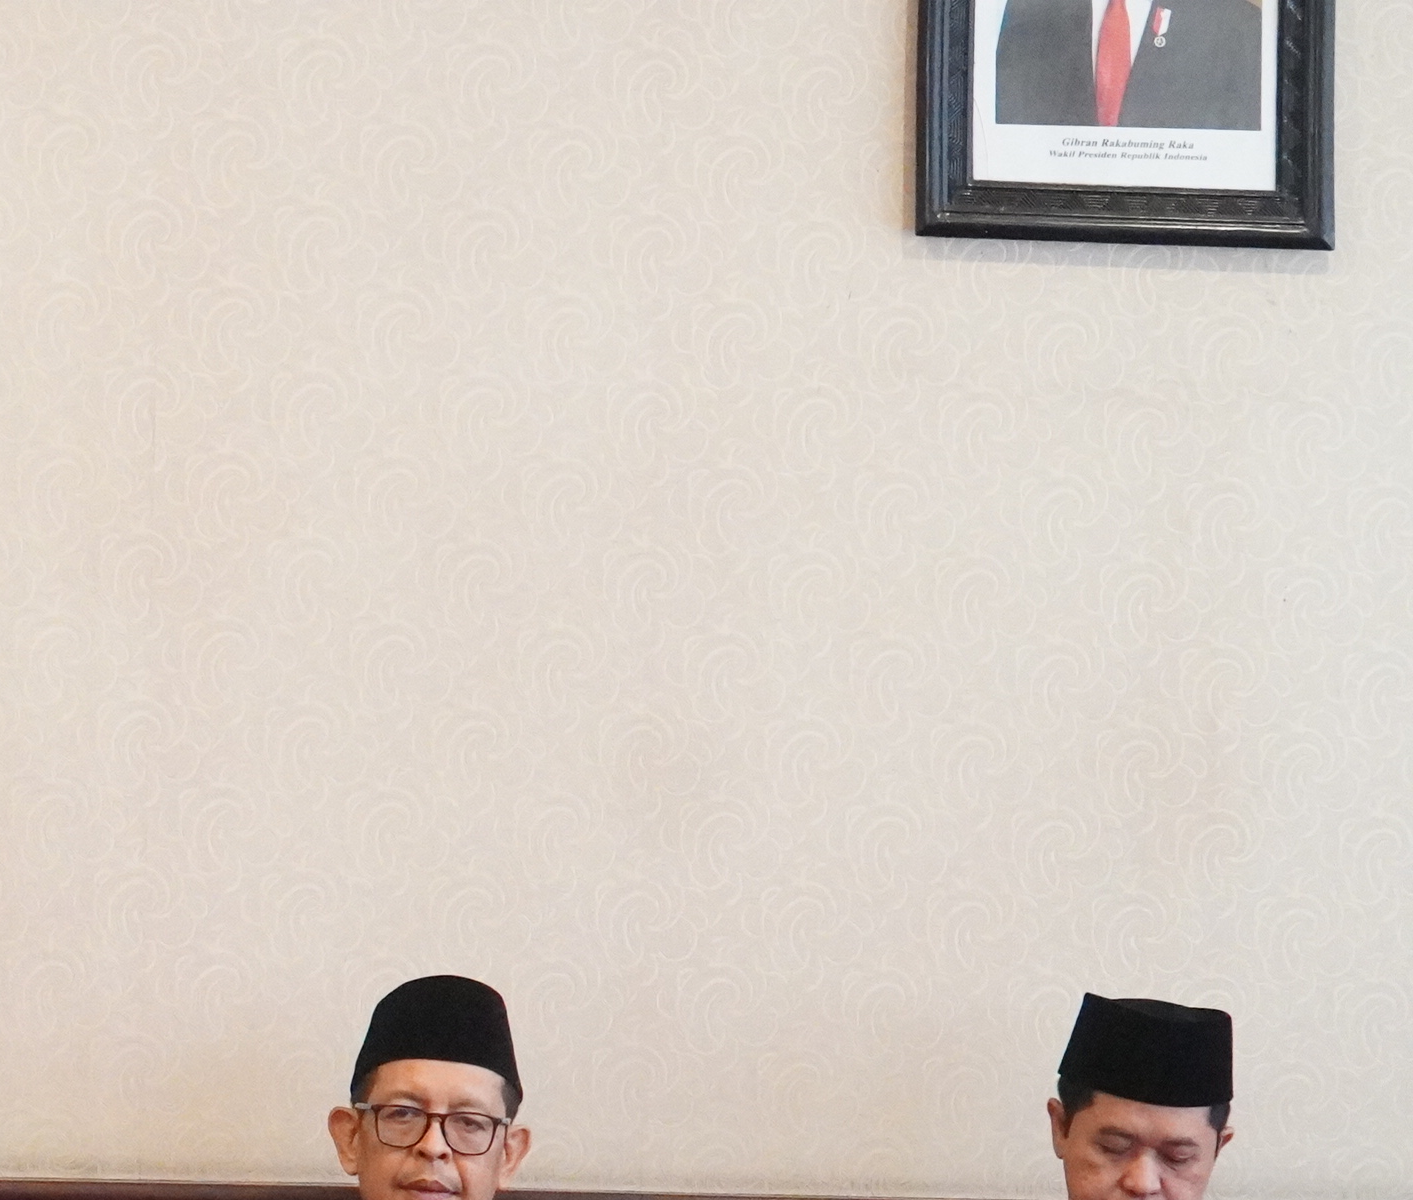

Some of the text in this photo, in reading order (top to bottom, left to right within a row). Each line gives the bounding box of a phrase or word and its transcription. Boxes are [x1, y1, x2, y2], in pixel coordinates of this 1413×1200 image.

[1062, 137, 1194, 150] Gibran Rakabuming Raka
[1049, 150, 1207, 161] Wakil Presiden Republik Indonesia
